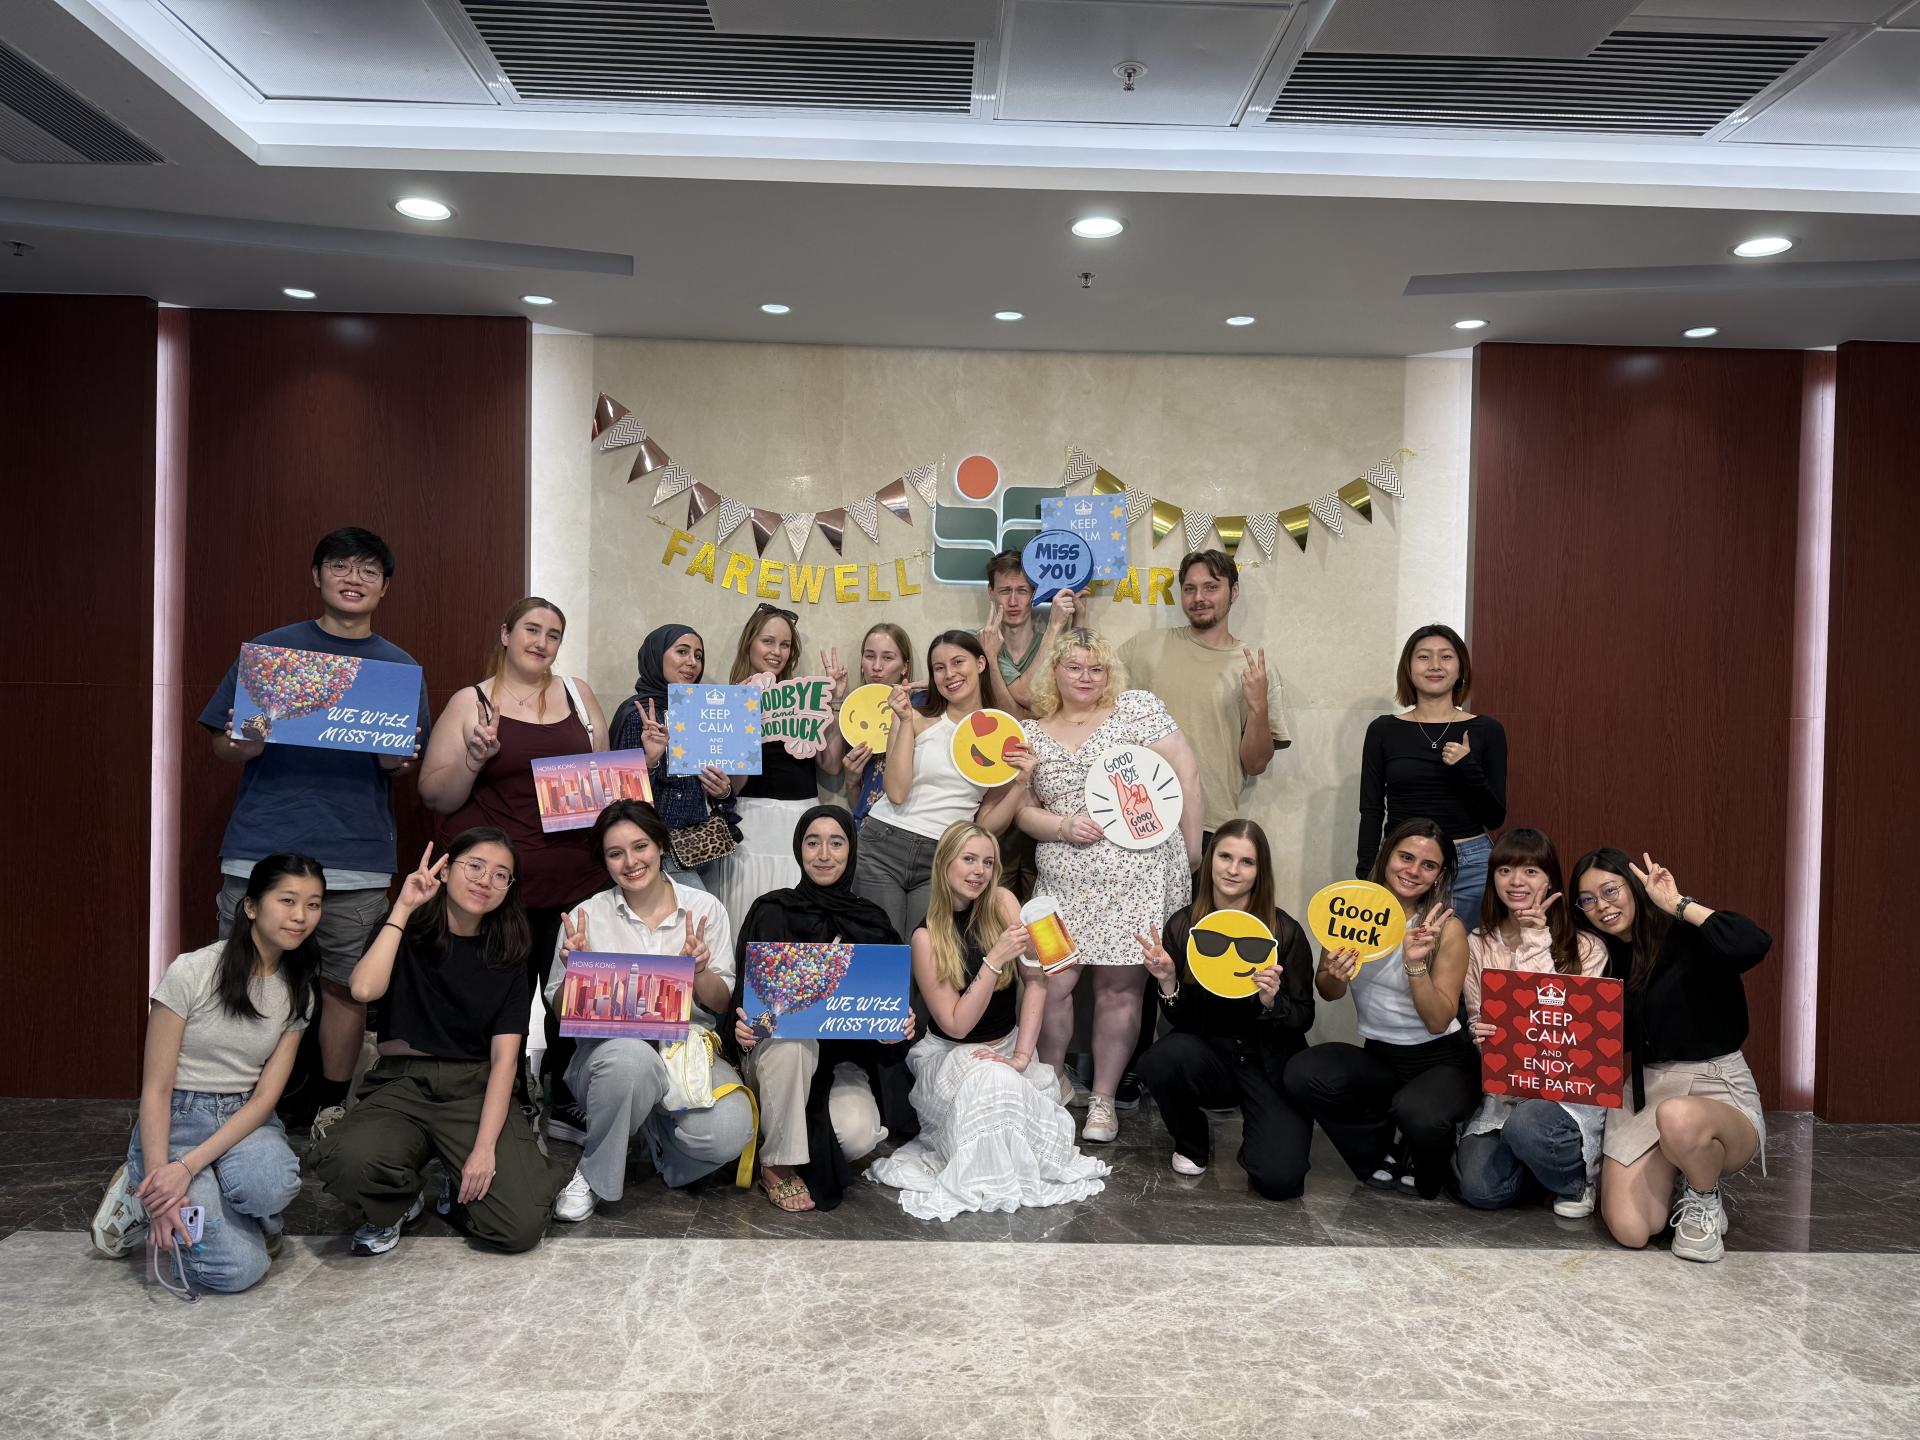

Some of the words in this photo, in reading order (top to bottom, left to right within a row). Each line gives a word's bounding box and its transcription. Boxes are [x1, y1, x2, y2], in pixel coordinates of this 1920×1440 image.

[1070, 519, 1098, 530] KEEP
[661, 528, 922, 604] FAREWELL
[1038, 563, 1077, 580] YOU
[761, 681, 832, 713] ODBYE
[327, 706, 360, 723] WE
[360, 710, 410, 728] WILL
[700, 708, 731, 720] KEEP
[771, 708, 798, 718] and
[698, 722, 734, 733] CALM
[318, 726, 373, 744] MISS
[370, 731, 416, 748] YOU!
[710, 745, 723, 754] BE
[698, 759, 735, 769] HAPPY
[1103, 752, 1133, 773] GOOD
[1121, 765, 1140, 785] BYE
[1130, 812, 1152, 827] GOOD
[1329, 897, 1391, 926] Good
[1328, 917, 1382, 946] Luck
[572, 960, 594, 968] HONG
[594, 961, 616, 969] KONG
[825, 995, 855, 1011] WE
[856, 996, 903, 1011] WILL
[818, 1017, 868, 1033] MISS
[867, 1017, 909, 1034] YOU!
[1529, 1010, 1573, 1027] KEEP
[1526, 1028, 1577, 1045] CALM
[1541, 1049, 1562, 1058] AND
[1523, 1057, 1575, 1075] ENJOY
[1507, 1074, 1540, 1090] THE
[1545, 1079, 1596, 1096] PARTY
